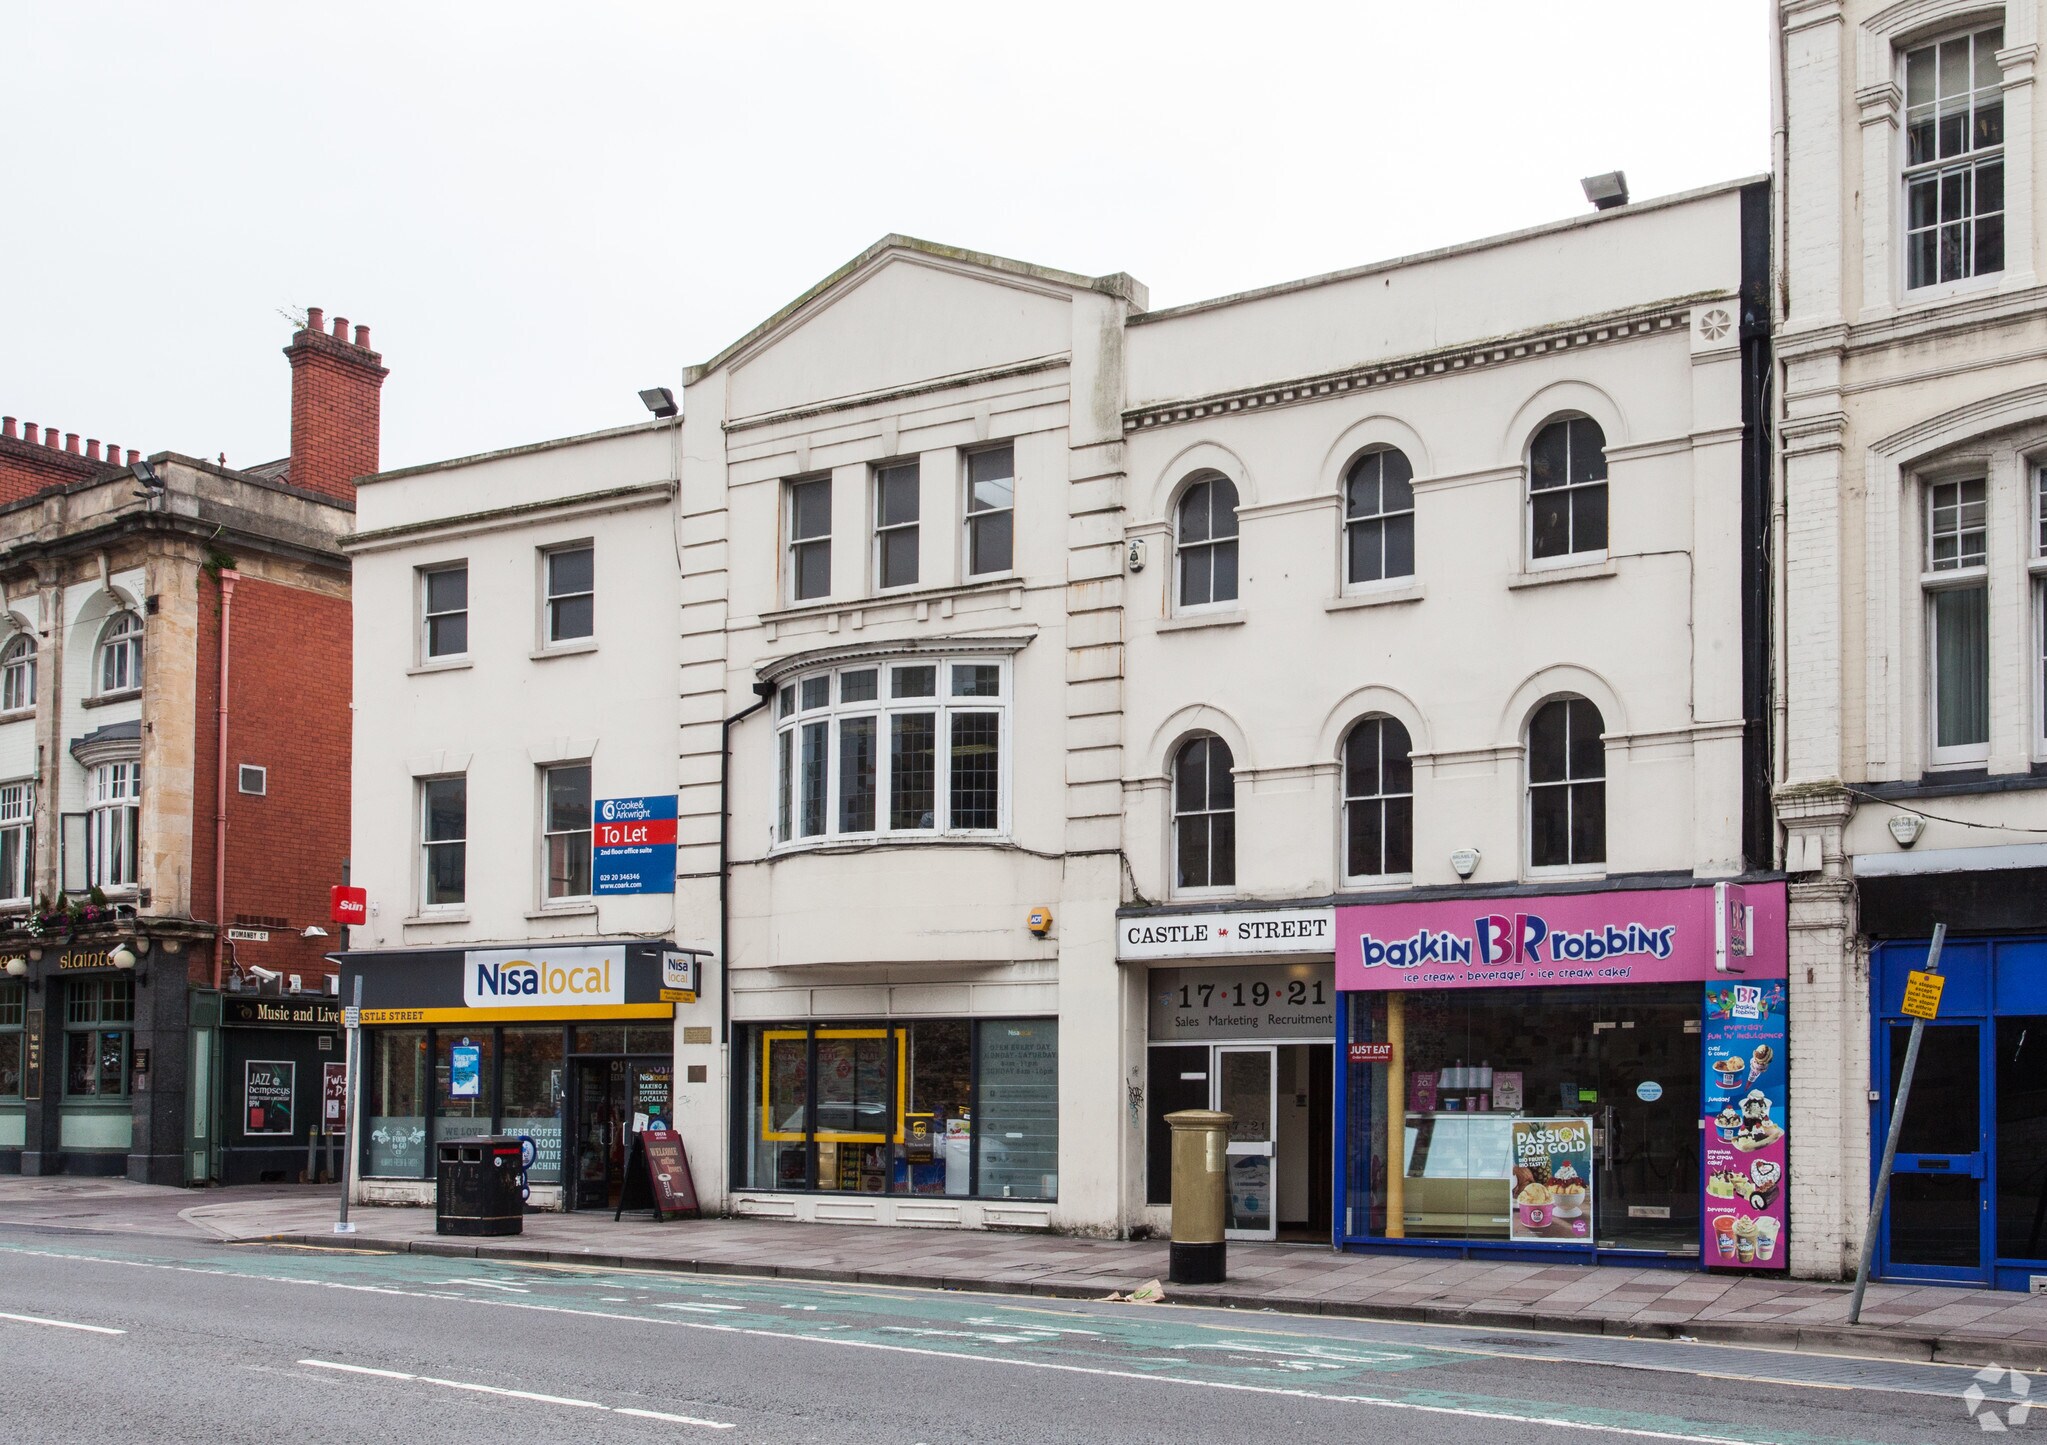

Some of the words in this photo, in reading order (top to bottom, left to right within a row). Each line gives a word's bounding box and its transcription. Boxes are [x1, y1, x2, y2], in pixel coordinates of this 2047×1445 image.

[616, 809, 650, 820] Arkwright
[602, 826, 620, 843] To
[624, 825, 647, 842] Let
[340, 900, 363, 911] Sun
[231, 931, 257, 940] WOMANBY
[1127, 924, 1208, 944] CASTLE
[1238, 919, 1327, 940] STREET
[668, 958, 688, 971] Nisa
[668, 972, 688, 983] local
[1404, 972, 1420, 983] ice
[1423, 973, 1456, 982] cream
[1467, 969, 1526, 982] beverages
[1538, 968, 1554, 979] ice
[1558, 969, 1594, 978] cream
[1598, 966, 1632, 978] cakes
[1179, 984, 1215, 1009] 17
[1232, 982, 1270, 1007] 19
[1287, 980, 1326, 1006] 21
[258, 1004, 290, 1021] Music
[294, 1006, 313, 1021] and
[318, 1006, 338, 1022] Live
[360, 1012, 386, 1021] ASTLE
[389, 1012, 424, 1020] STREET
[1175, 1016, 1199, 1027] Sales
[1208, 1014, 1258, 1028] Marketing
[1268, 1012, 1332, 1026] Recruitment
[1350, 1046, 1372, 1054] JUST
[1374, 1046, 1390, 1054] EAT
[250, 1073, 271, 1086] JAZZ
[445, 1128, 458, 1136] WE
[502, 1128, 529, 1136] FRESH
[1516, 1127, 1585, 1145] PASSION
[1518, 1145, 1544, 1156] FOR
[1548, 1140, 1586, 1154] GOLD
